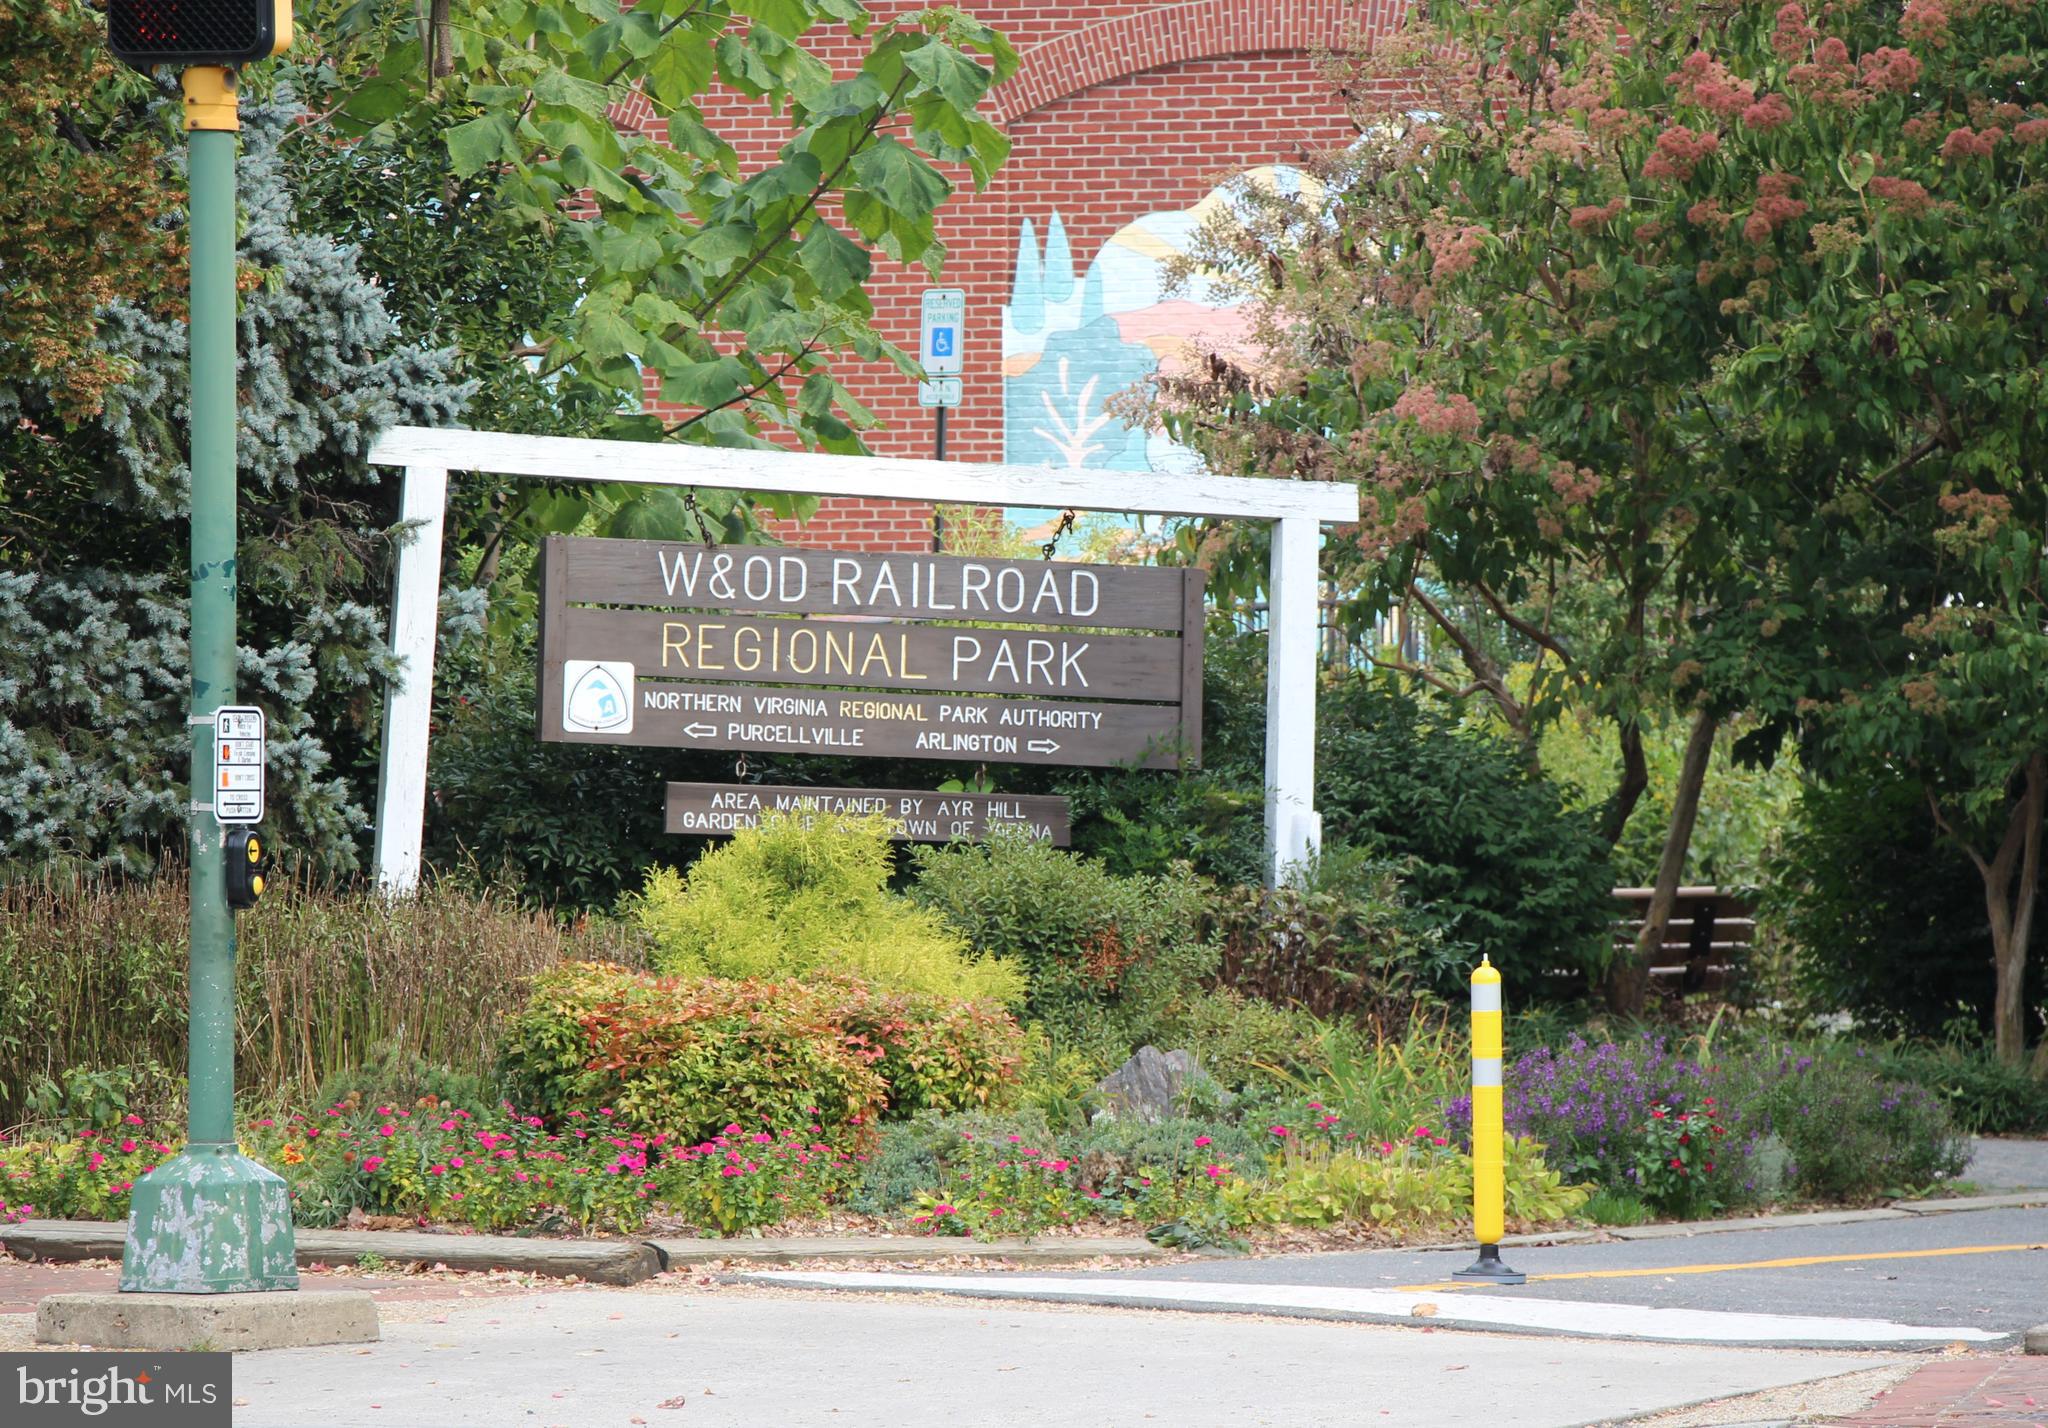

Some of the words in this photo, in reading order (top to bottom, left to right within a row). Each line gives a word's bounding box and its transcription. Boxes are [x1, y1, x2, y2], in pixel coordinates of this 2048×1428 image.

[658, 550, 807, 602] W&OD
[832, 558, 1099, 617] RAILROAD
[662, 622, 927, 680] REGIONAL
[953, 636, 1089, 688] PARK
[644, 691, 741, 713] NORTHERN
[754, 696, 828, 717] VIRGINIA
[839, 701, 928, 721] REGIONAL
[939, 705, 988, 724] PARK
[1000, 708, 1102, 730] AUTHORITY
[727, 723, 864, 746] PURCELLVILLE
[916, 732, 1017, 753] ARLINGTON
[711, 792, 761, 810] AREA
[776, 794, 886, 813] MAINTAINED
[900, 798, 923, 815] BY
[937, 800, 973, 817] AYR
[987, 801, 1027, 819] HILL
[683, 812, 756, 830] GARDEN
[886, 819, 937, 837] OWN
[951, 821, 974, 837] OF
